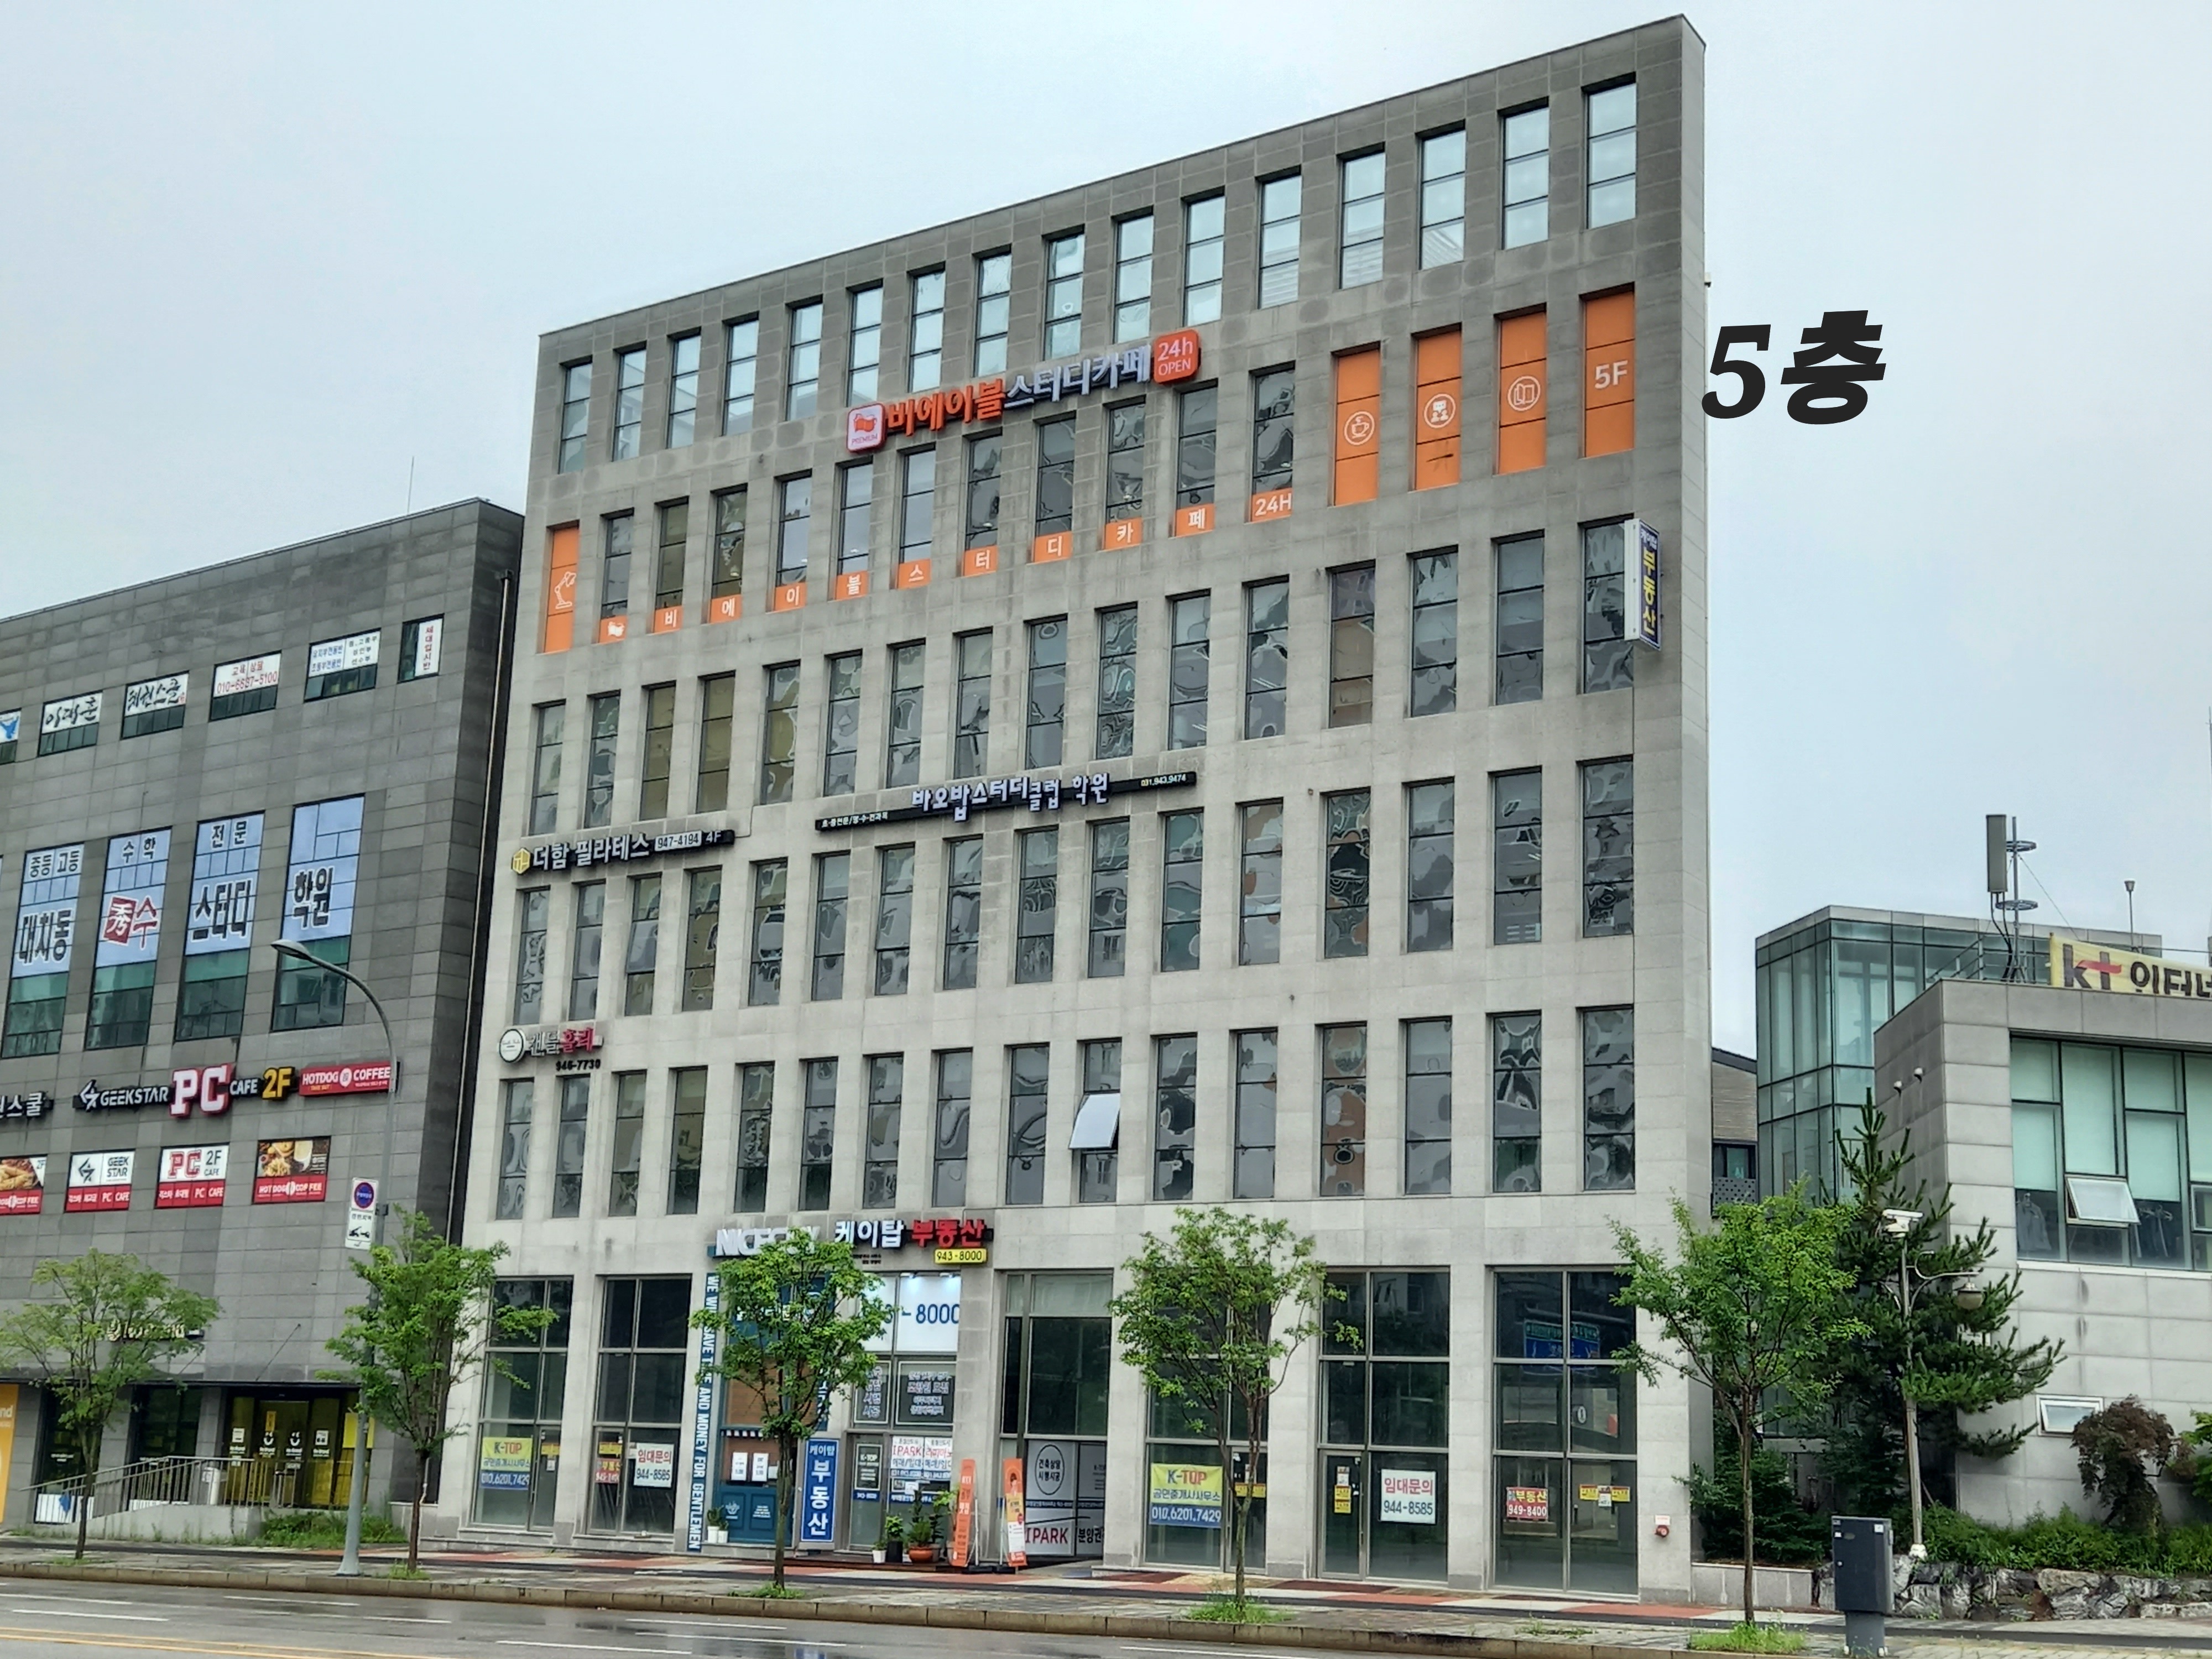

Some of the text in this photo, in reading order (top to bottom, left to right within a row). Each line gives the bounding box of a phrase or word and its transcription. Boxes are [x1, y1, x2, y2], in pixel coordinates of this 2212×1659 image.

[1158, 337, 1193, 362] 24h
[1159, 359, 1191, 376] OPEN
[1595, 361, 1628, 389] 5F
[888, 344, 1151, 436] 비에이블 스터디카페
[1255, 492, 1292, 517] 24H
[1643, 546, 1656, 636] 부동산
[1072, 773, 1108, 805] 학원
[212, 821, 247, 848] 전문
[123, 837, 156, 864] 수학
[533, 833, 650, 870] 더함 필라테스
[294, 867, 333, 928] 학원
[193, 880, 252, 939] 스터디
[19, 910, 72, 964] 대치동
[100, 1086, 169, 1107] GEEKSTAR
[170, 1065, 228, 1116] PC
[229, 1079, 258, 1095] CAFE
[262, 1067, 292, 1099] 2F
[302, 1072, 339, 1086] HOTDOG
[353, 1067, 390, 1081] COFFEE
[107, 1156, 130, 1167] GEEK
[107, 1167, 128, 1177] STAR
[168, 1150, 222, 1178] PC 2F
[102, 1192, 113, 1202] PC
[195, 1187, 205, 1198] PC
[834, 1219, 985, 1249] 케이탑 부동산
[937, 1251, 983, 1261] 943-8000
[707, 1276, 719, 1292] WE
[702, 1326, 716, 1354] SAVE
[698, 1387, 711, 1410] AND
[695, 1413, 708, 1453] MONEY
[494, 1442, 522, 1454] K-TOP
[638, 1449, 672, 1465] 임대문의
[810, 1444, 835, 1457] 케이탑
[893, 1445, 922, 1456] IPARK
[693, 1456, 706, 1478] FOR
[1167, 1469, 1208, 1485] K-TOP
[808, 1460, 831, 1536] 부동산
[1153, 1488, 1221, 1501] 공인중개사사무소
[1385, 1478, 1433, 1496] 임대문의
[1516, 1490, 1547, 1503] 부동산
[689, 1483, 704, 1549] GENTLEMEN
[1151, 1507, 1222, 1523] 010.6201.7429
[1384, 1500, 1433, 1515] 944-8585
[1508, 1504, 1547, 1517] 949-8400
[1026, 1527, 1068, 1544] IPARK
